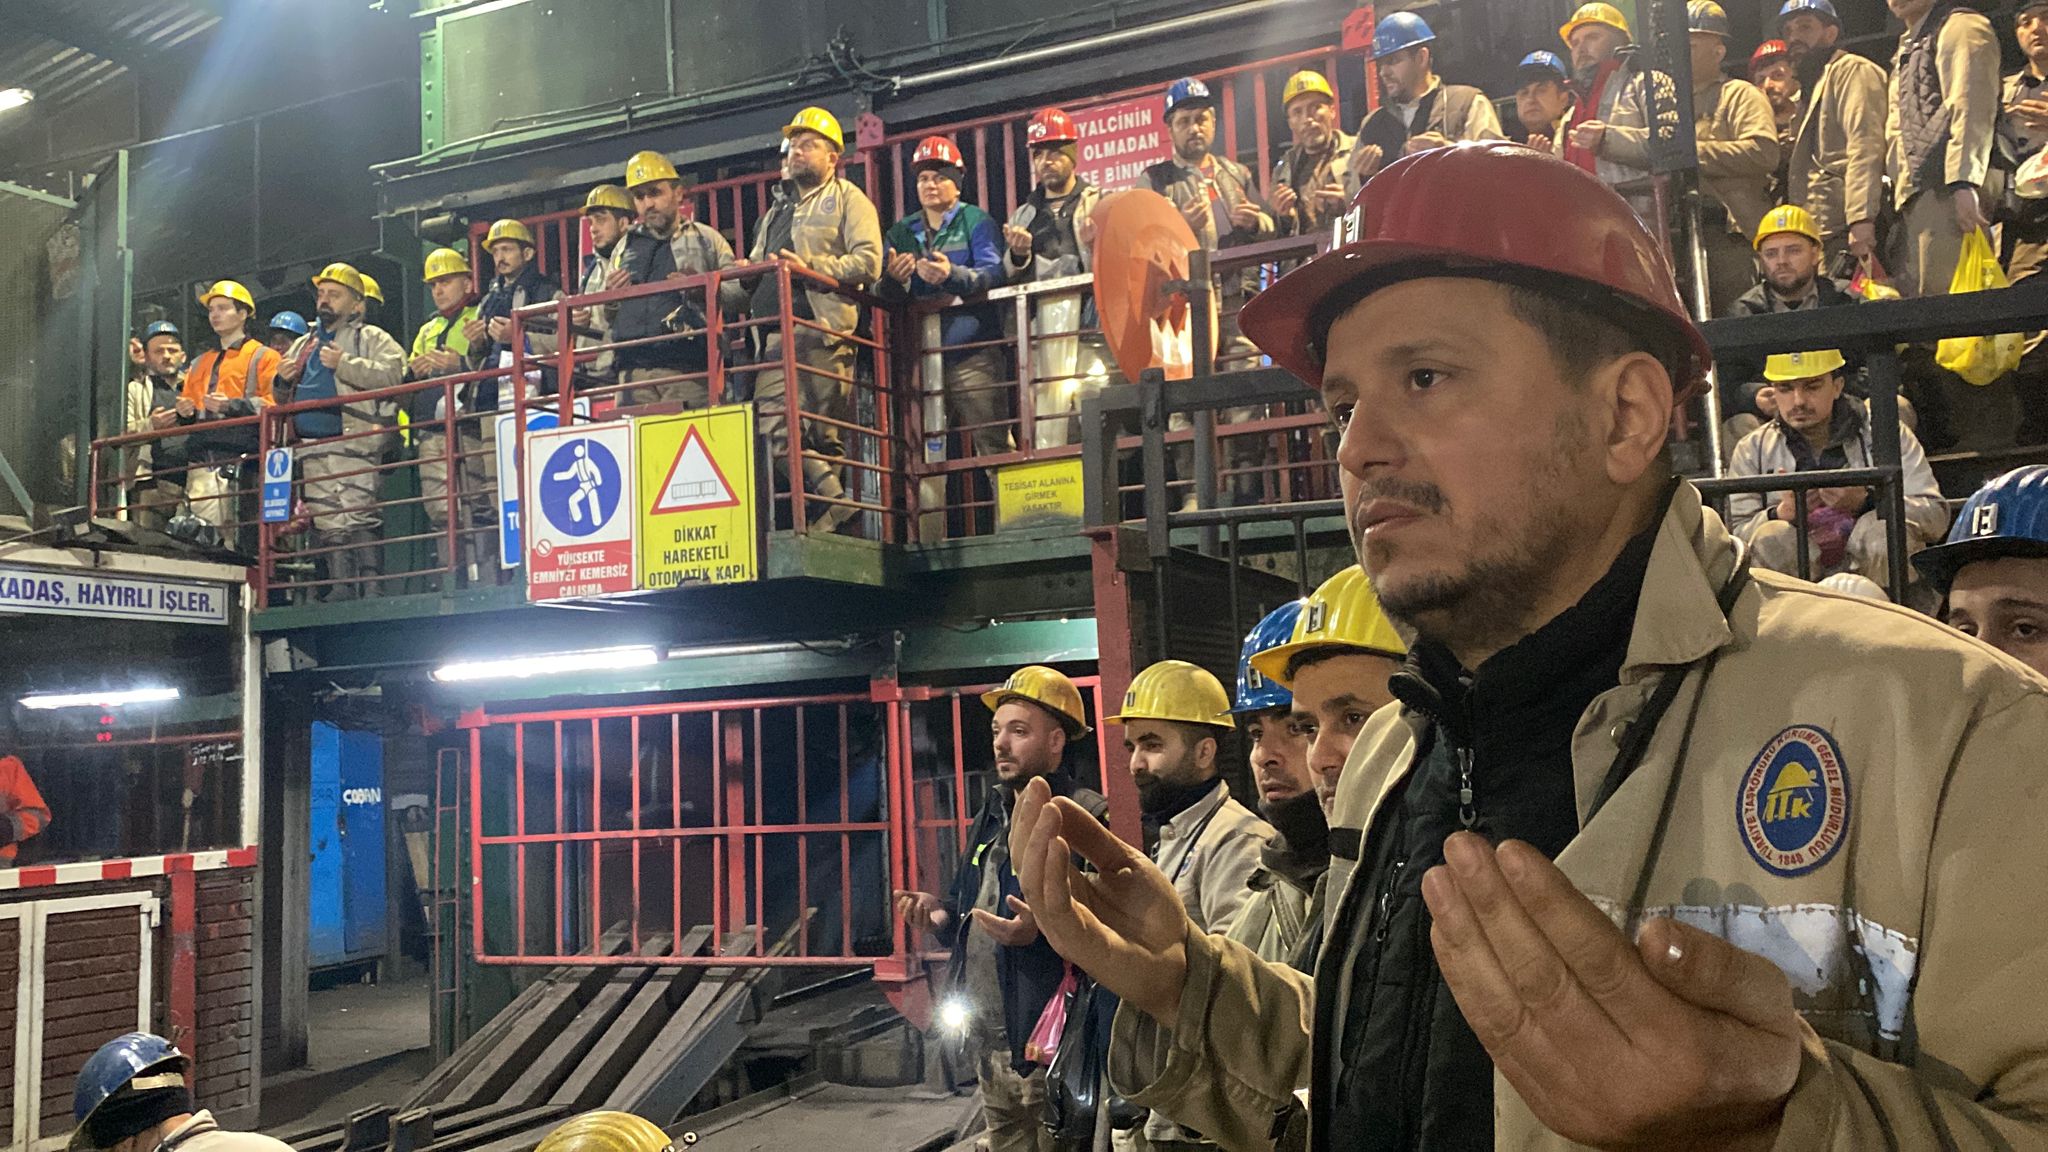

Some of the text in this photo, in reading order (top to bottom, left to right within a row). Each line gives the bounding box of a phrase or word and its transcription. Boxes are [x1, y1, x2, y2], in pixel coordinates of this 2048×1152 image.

[1083, 132, 1159, 161] OLMADAN
[674, 525, 717, 543] DİKKAT
[557, 550, 605, 566] YÜKSEKTE
[663, 541, 729, 565] HAREKETLİ
[533, 562, 628, 584] EMNİYET KEMERSİZ
[716, 564, 745, 580] KAPI
[78, 583, 152, 609] HAYIRLI
[159, 585, 215, 614] İŞLER.
[1817, 744, 1840, 783] GENEL
